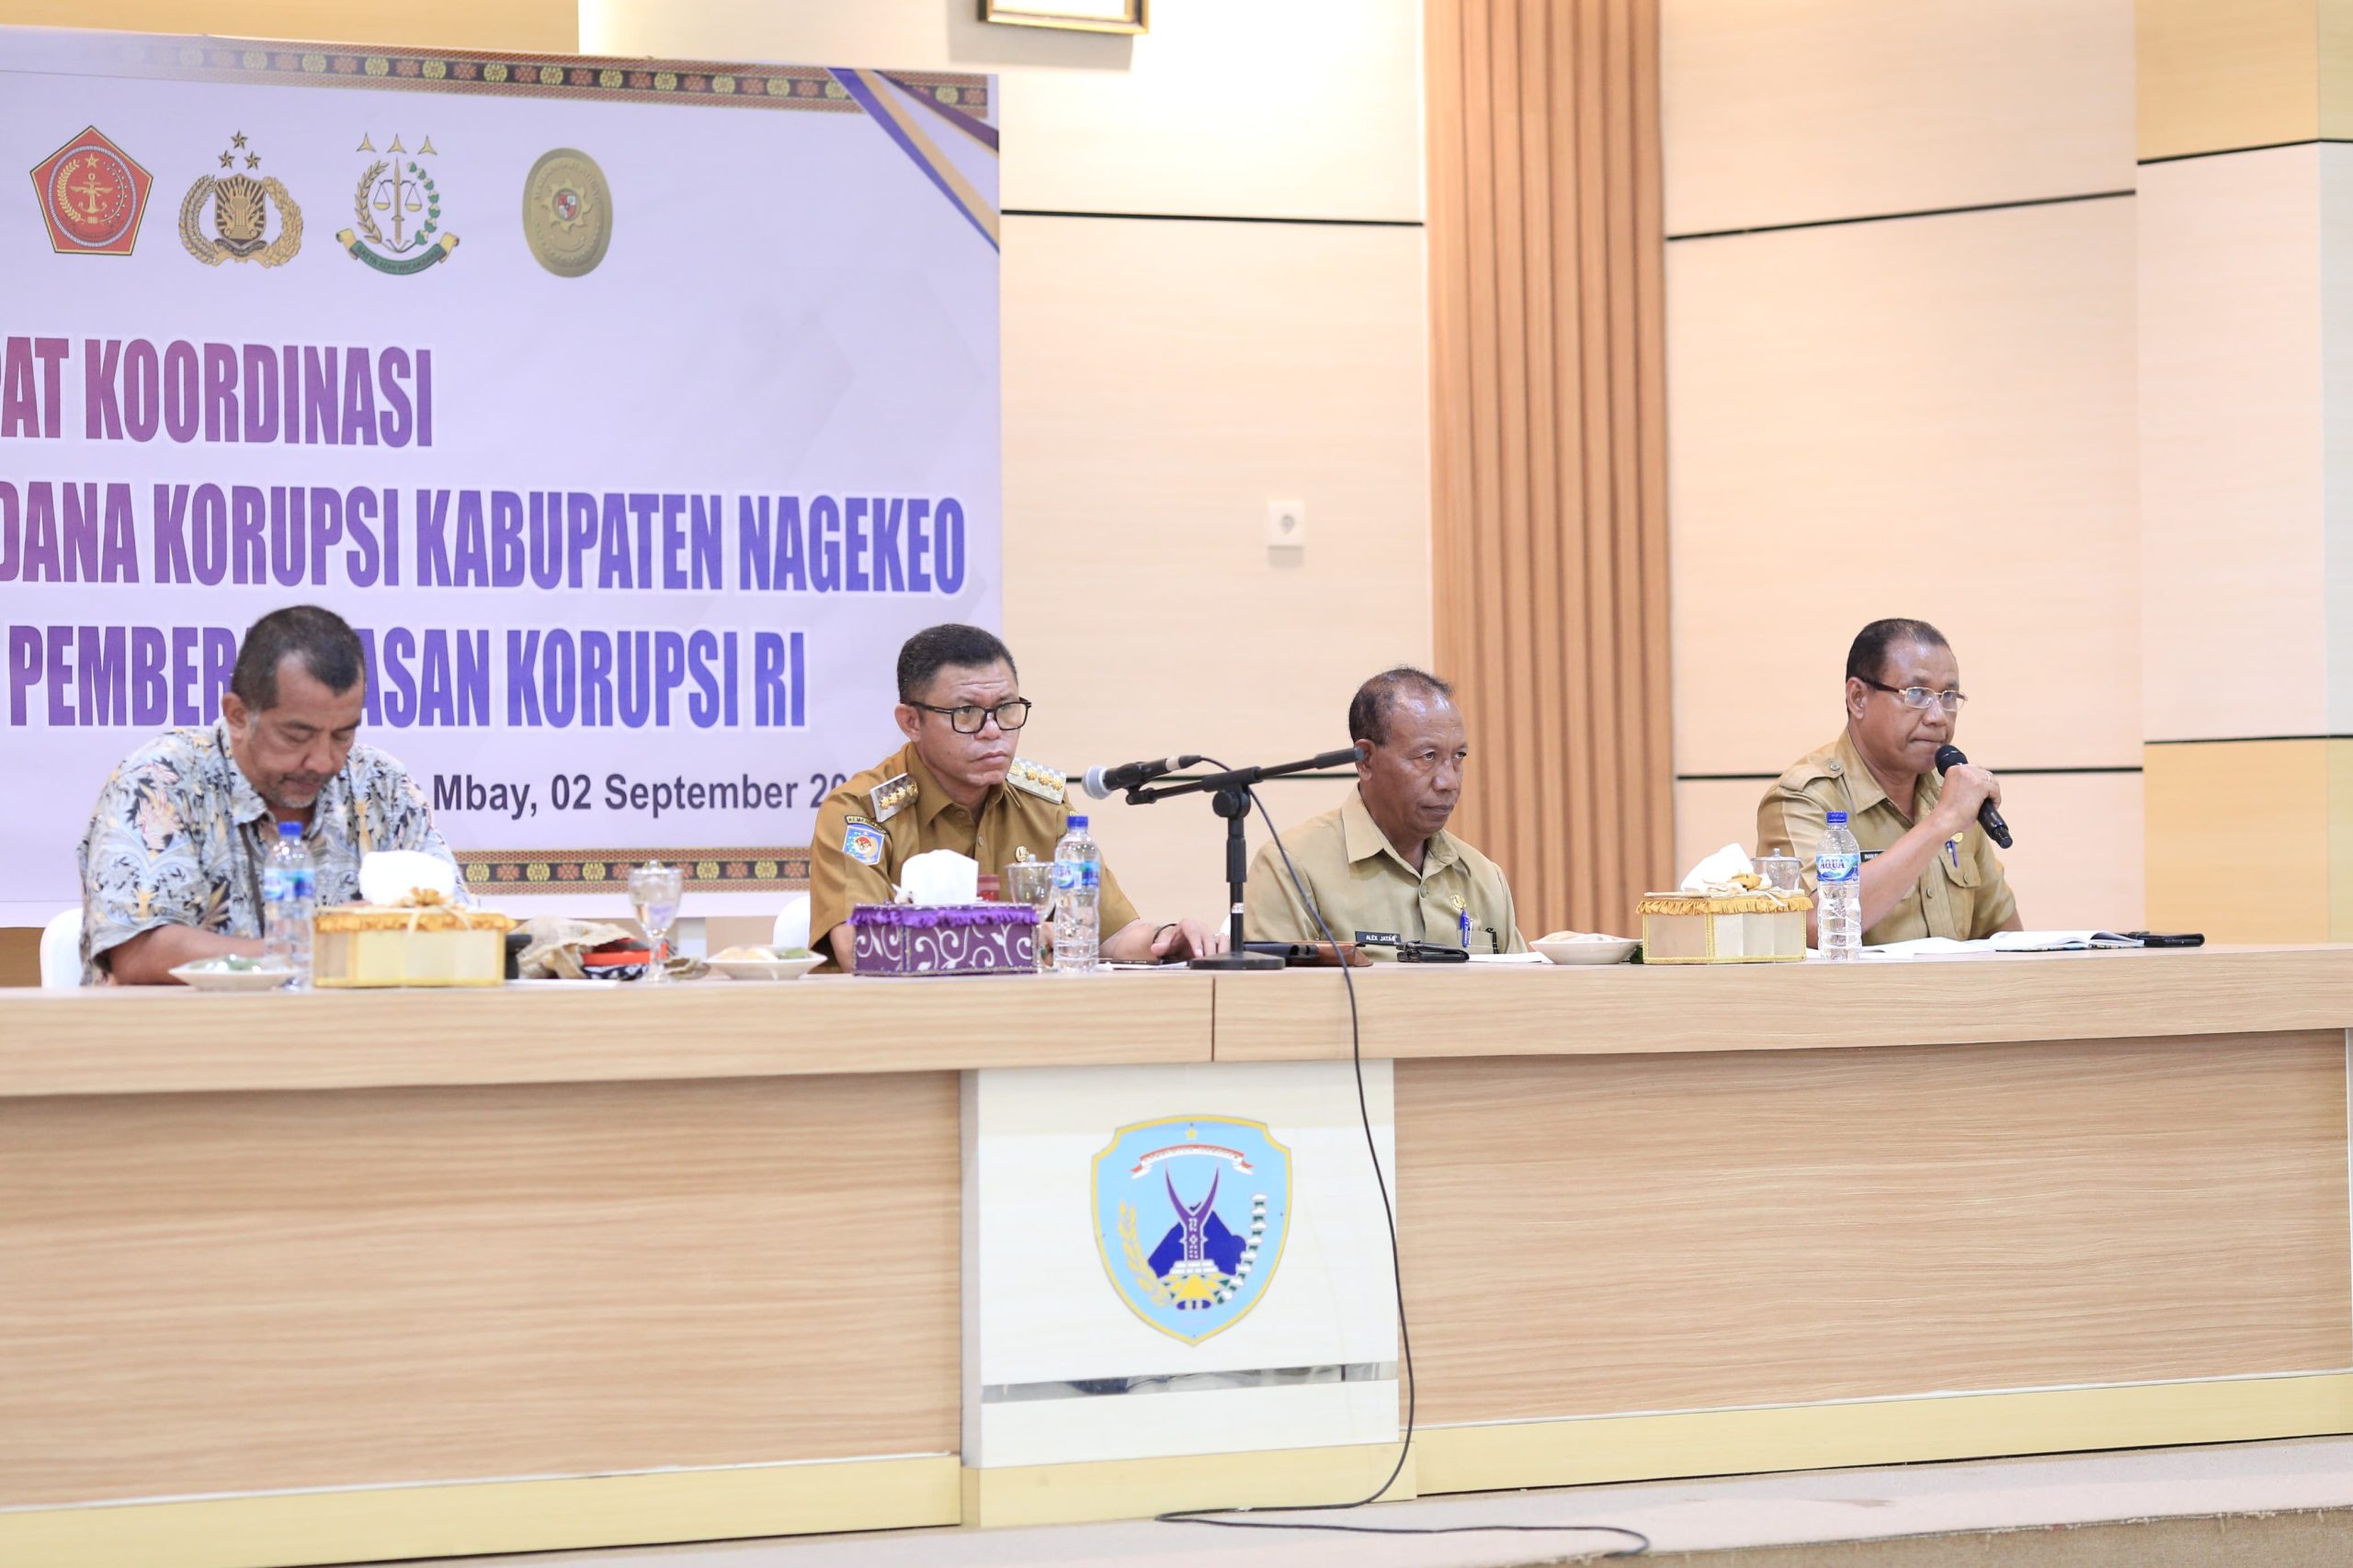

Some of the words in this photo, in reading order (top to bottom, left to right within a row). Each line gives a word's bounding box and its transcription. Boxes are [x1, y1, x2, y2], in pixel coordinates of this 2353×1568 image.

[0, 336, 69, 438] AT
[85, 338, 432, 448] KOORDINASI
[154, 483, 399, 587] KORUPSI
[416, 490, 722, 590] KABUPATEN
[739, 495, 965, 595] NAGEKEO
[9, 625, 490, 729] PEMBERASAN
[506, 629, 738, 729] KORUPSI
[755, 632, 805, 727] RI
[433, 774, 538, 821] Mbay,
[551, 774, 591, 810] 02
[605, 773, 798, 819] September
[1820, 858, 1845, 871] AQUA
